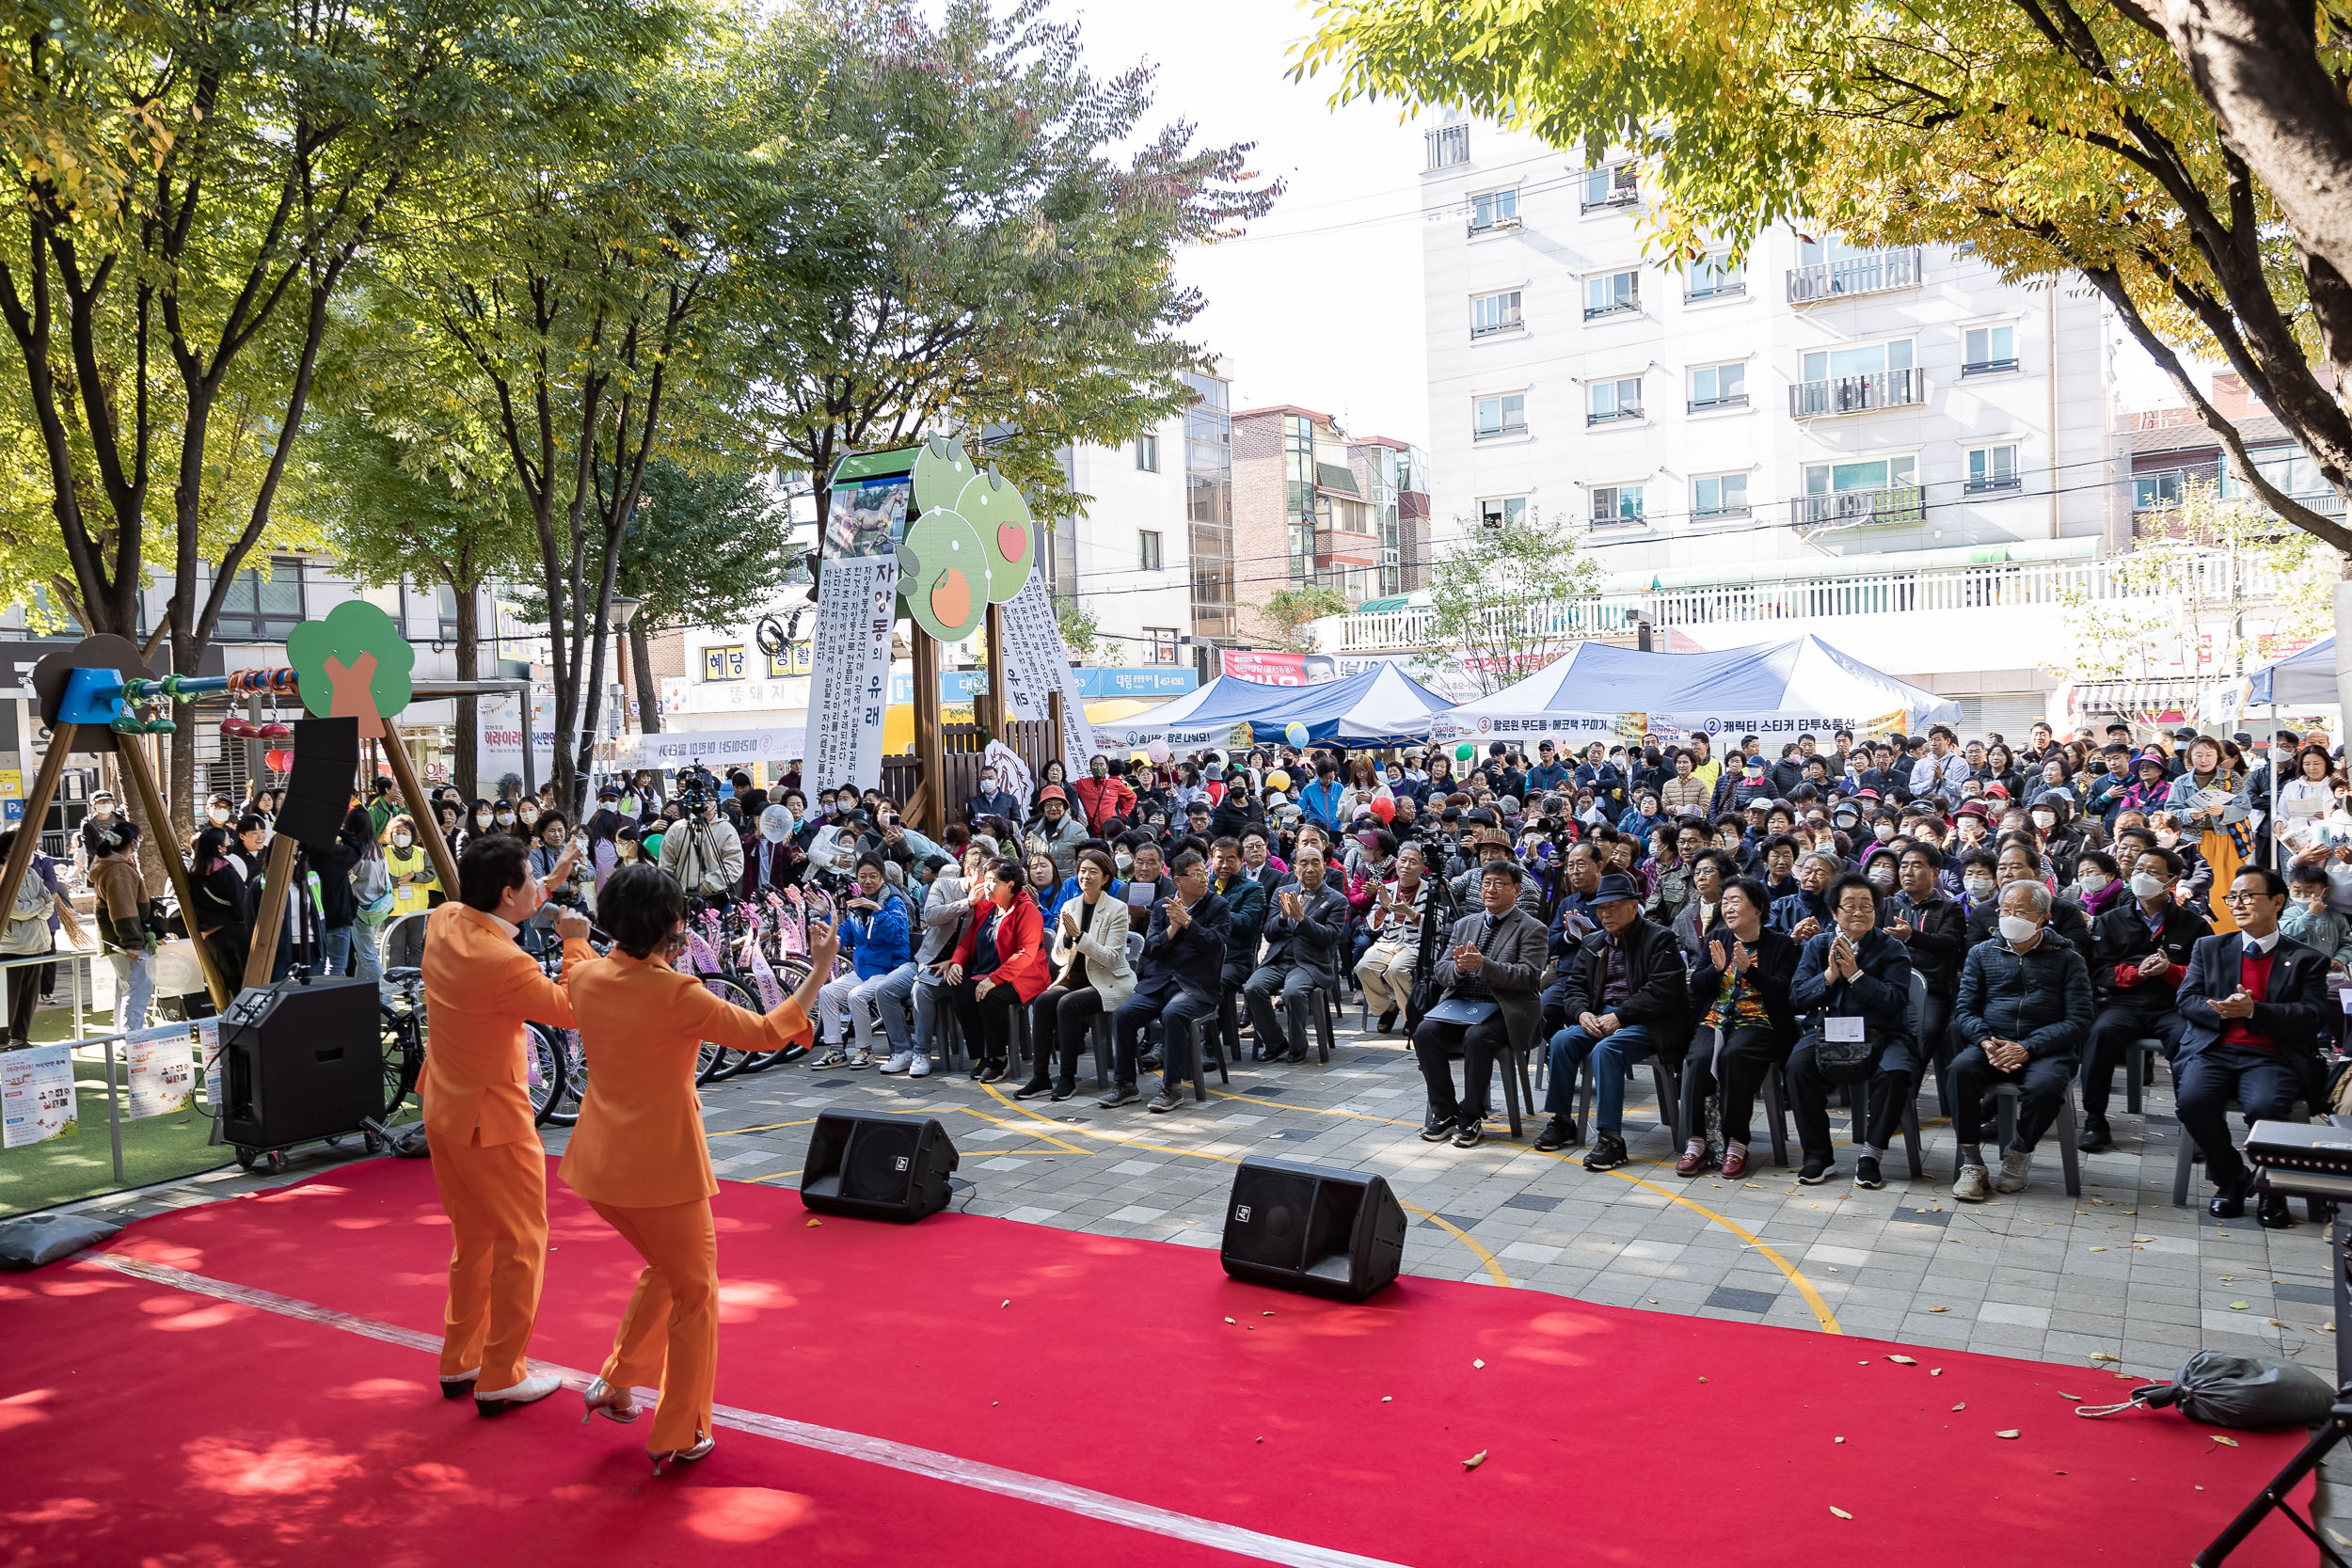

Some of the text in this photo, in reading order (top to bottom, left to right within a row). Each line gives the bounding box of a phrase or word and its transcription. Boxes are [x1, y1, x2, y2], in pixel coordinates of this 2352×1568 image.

[833, 567, 842, 597] 난다고
[843, 567, 851, 587] 조선
[863, 566, 872, 596] 자양동
[842, 589, 850, 599] 초
[817, 568, 832, 667] 자마장이라 칭하였다.
[831, 600, 839, 620] 하여
[838, 602, 849, 641] 국가에서
[860, 598, 868, 628] 동명은
[830, 623, 837, 632] 이
[848, 602, 858, 651] 자양동으로
[826, 635, 836, 674] 지역에서
[856, 632, 866, 671] 조선시대
[866, 562, 895, 727] 자양동의 유래
[824, 677, 833, 699] 암말
[1116, 673, 1132, 689] 대림
[843, 688, 851, 707] 데서
[852, 674, 863, 715] 이곳에서
[850, 718, 859, 749] 암말을
[1129, 735, 1136, 743] 4
[1184, 732, 1211, 743] 나눠요!
[1482, 720, 1487, 729] 3
[1493, 720, 1519, 732] 할로윈
[1581, 719, 1608, 731] 꾸미기
[1708, 718, 1855, 733] 2 캐릭터 스티커 타투&풍선
[829, 735, 837, 765] 기르면
[838, 710, 849, 768] 유래되었다.
[425, 762, 445, 782] 약
[848, 752, 857, 771] 길러
[8, 803, 16, 815] P
